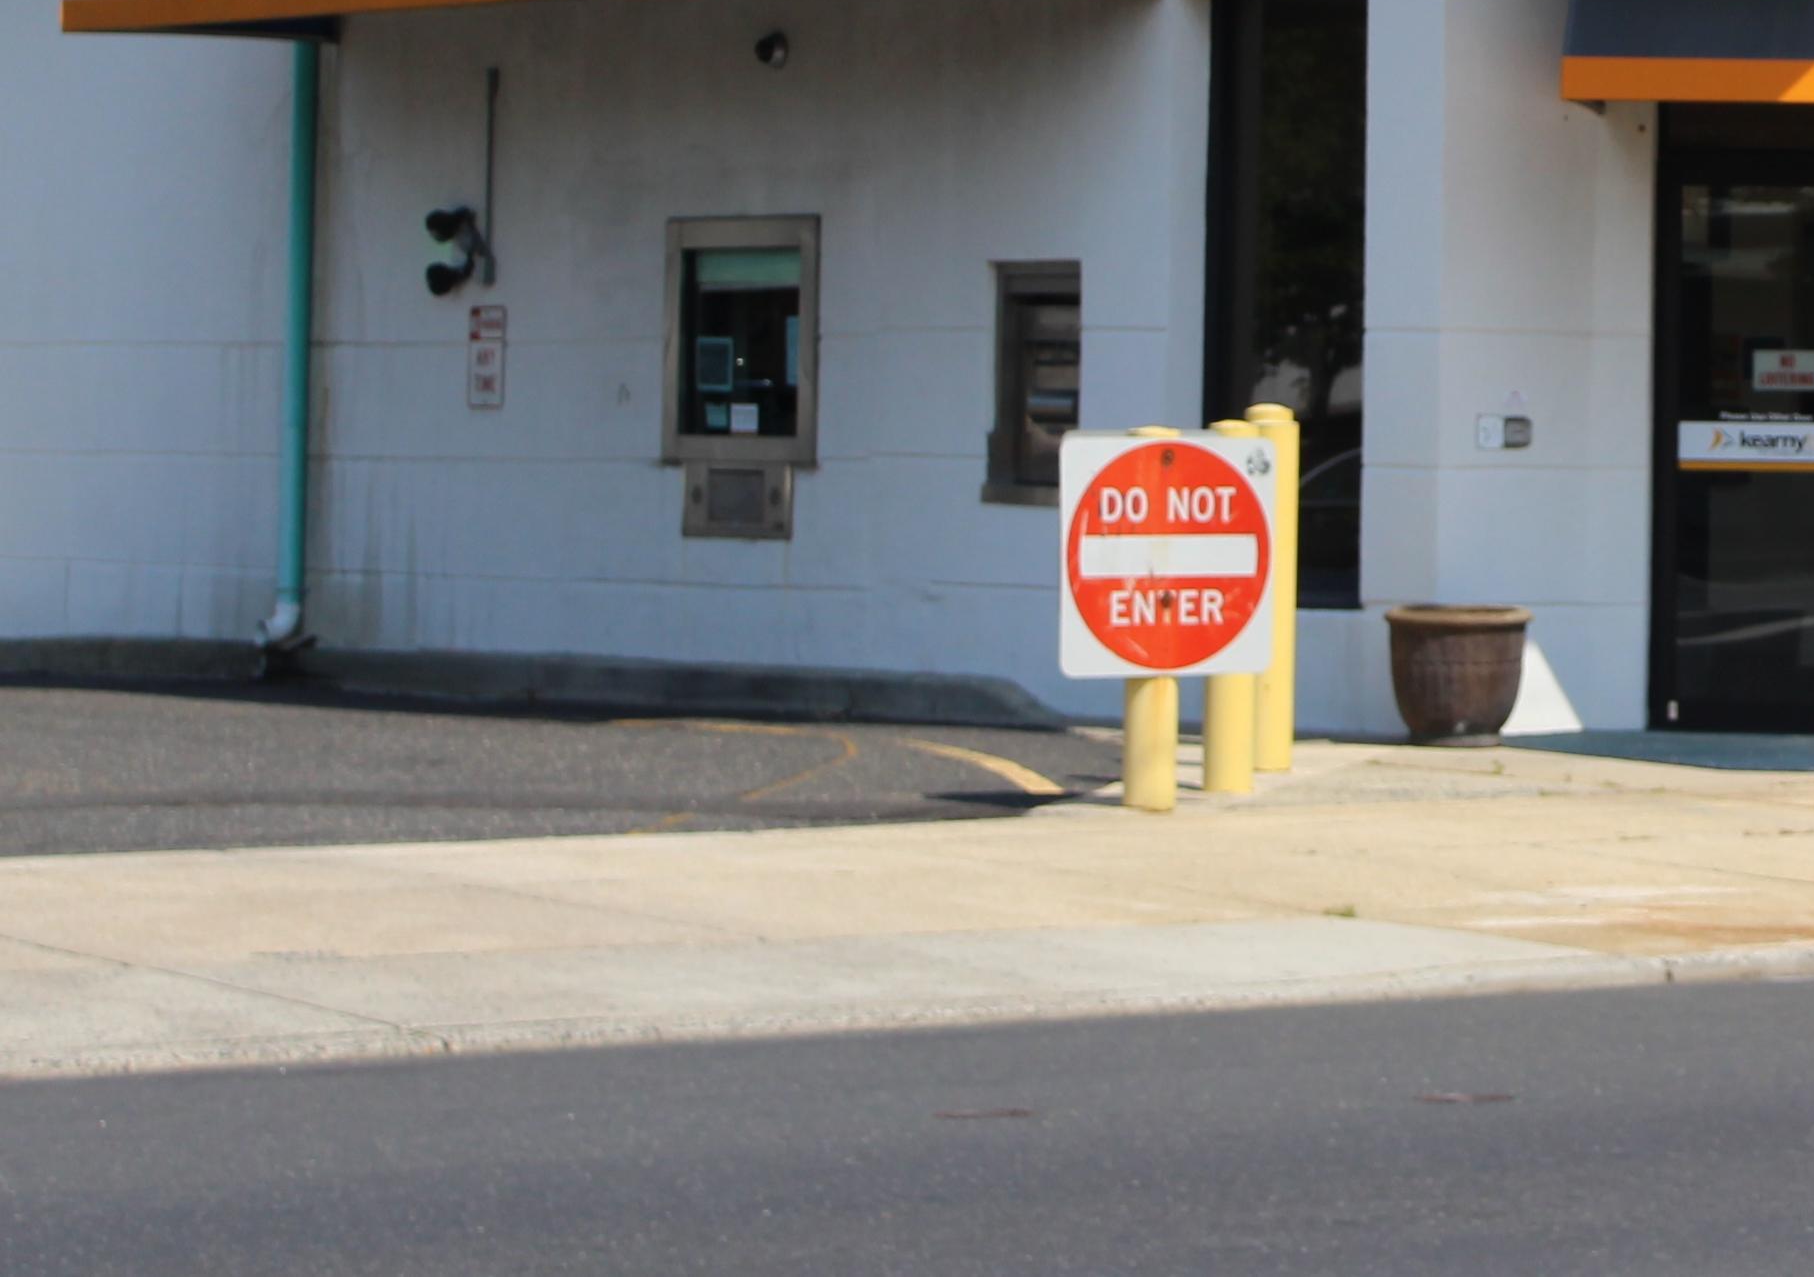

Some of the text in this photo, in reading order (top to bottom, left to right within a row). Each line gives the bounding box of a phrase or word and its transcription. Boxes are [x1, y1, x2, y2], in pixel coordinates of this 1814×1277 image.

[1101, 485, 1238, 524] DO NOT
[1109, 588, 1226, 627] ENTER
